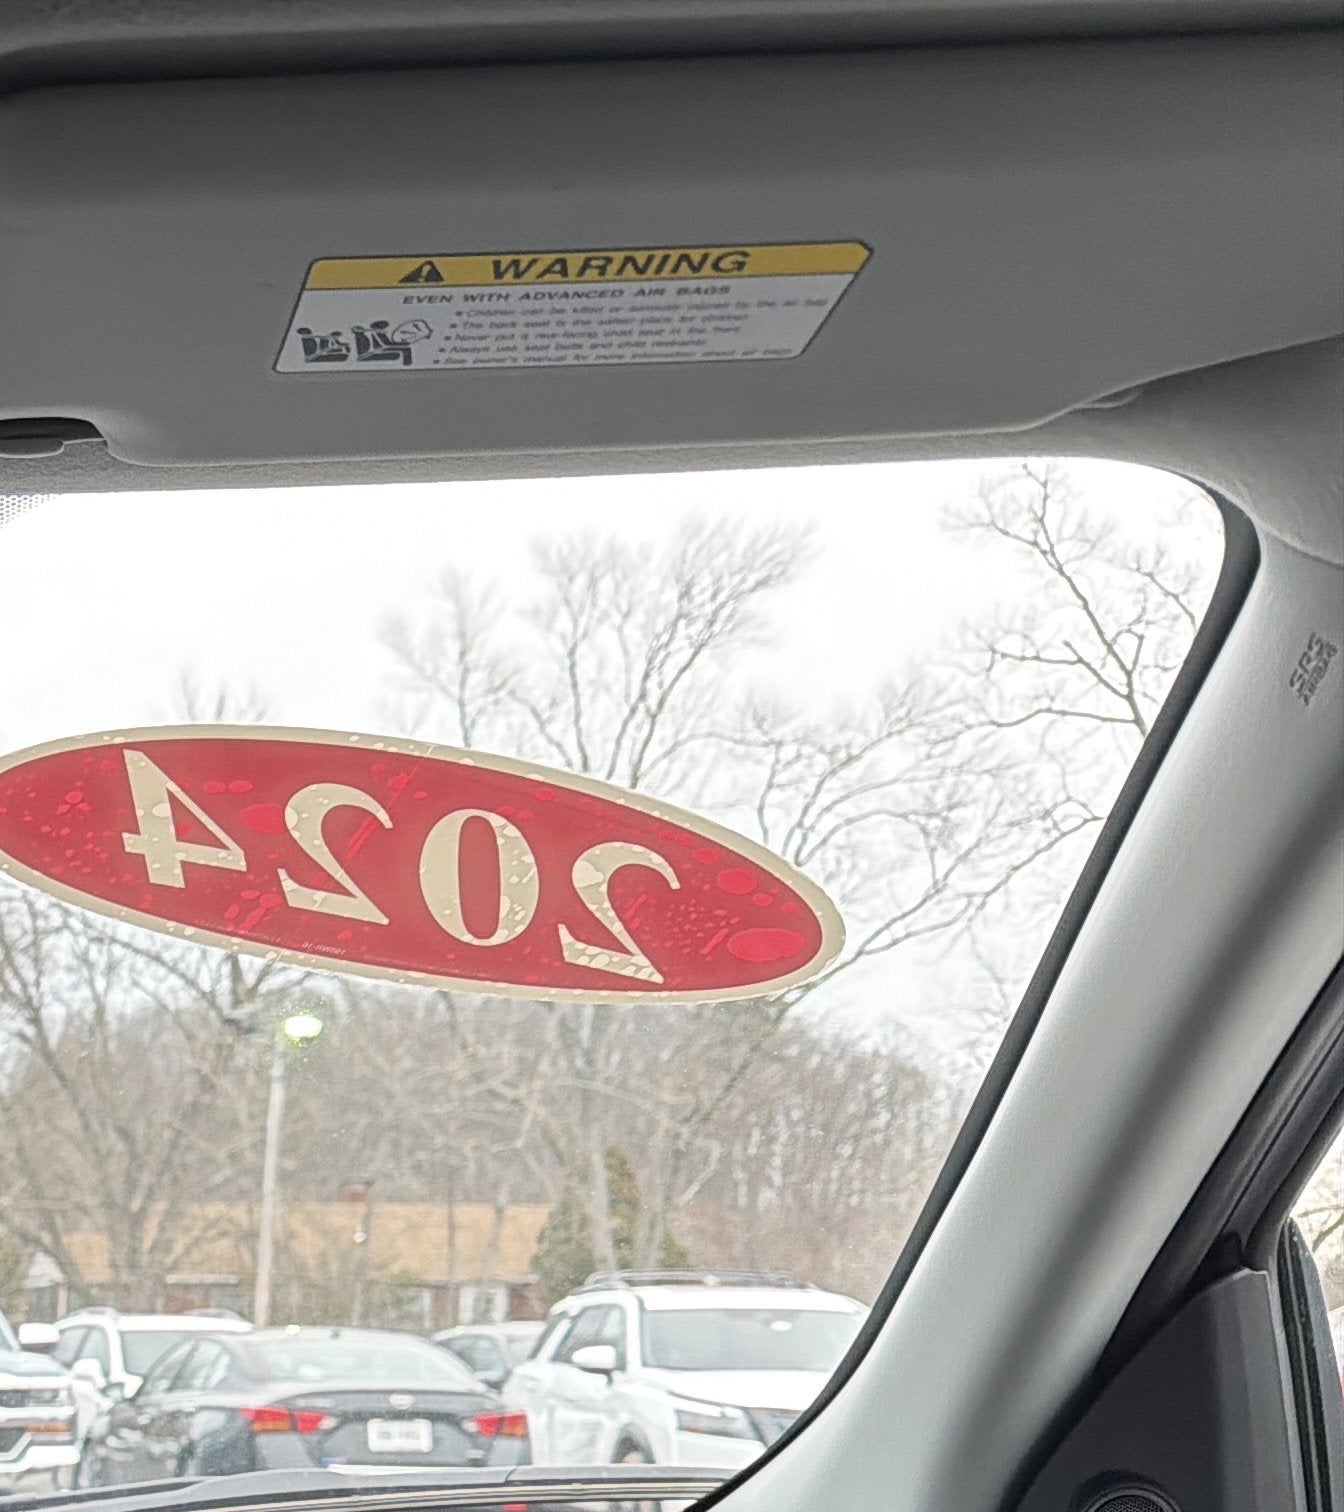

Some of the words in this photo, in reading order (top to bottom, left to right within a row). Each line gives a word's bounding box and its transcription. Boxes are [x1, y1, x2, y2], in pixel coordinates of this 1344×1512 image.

[491, 250, 752, 280] WARNING
[402, 294, 454, 305] EVEN
[462, 292, 511, 303] WITH
[520, 288, 626, 301] ADVANCED
[633, 287, 667, 298] AIR
